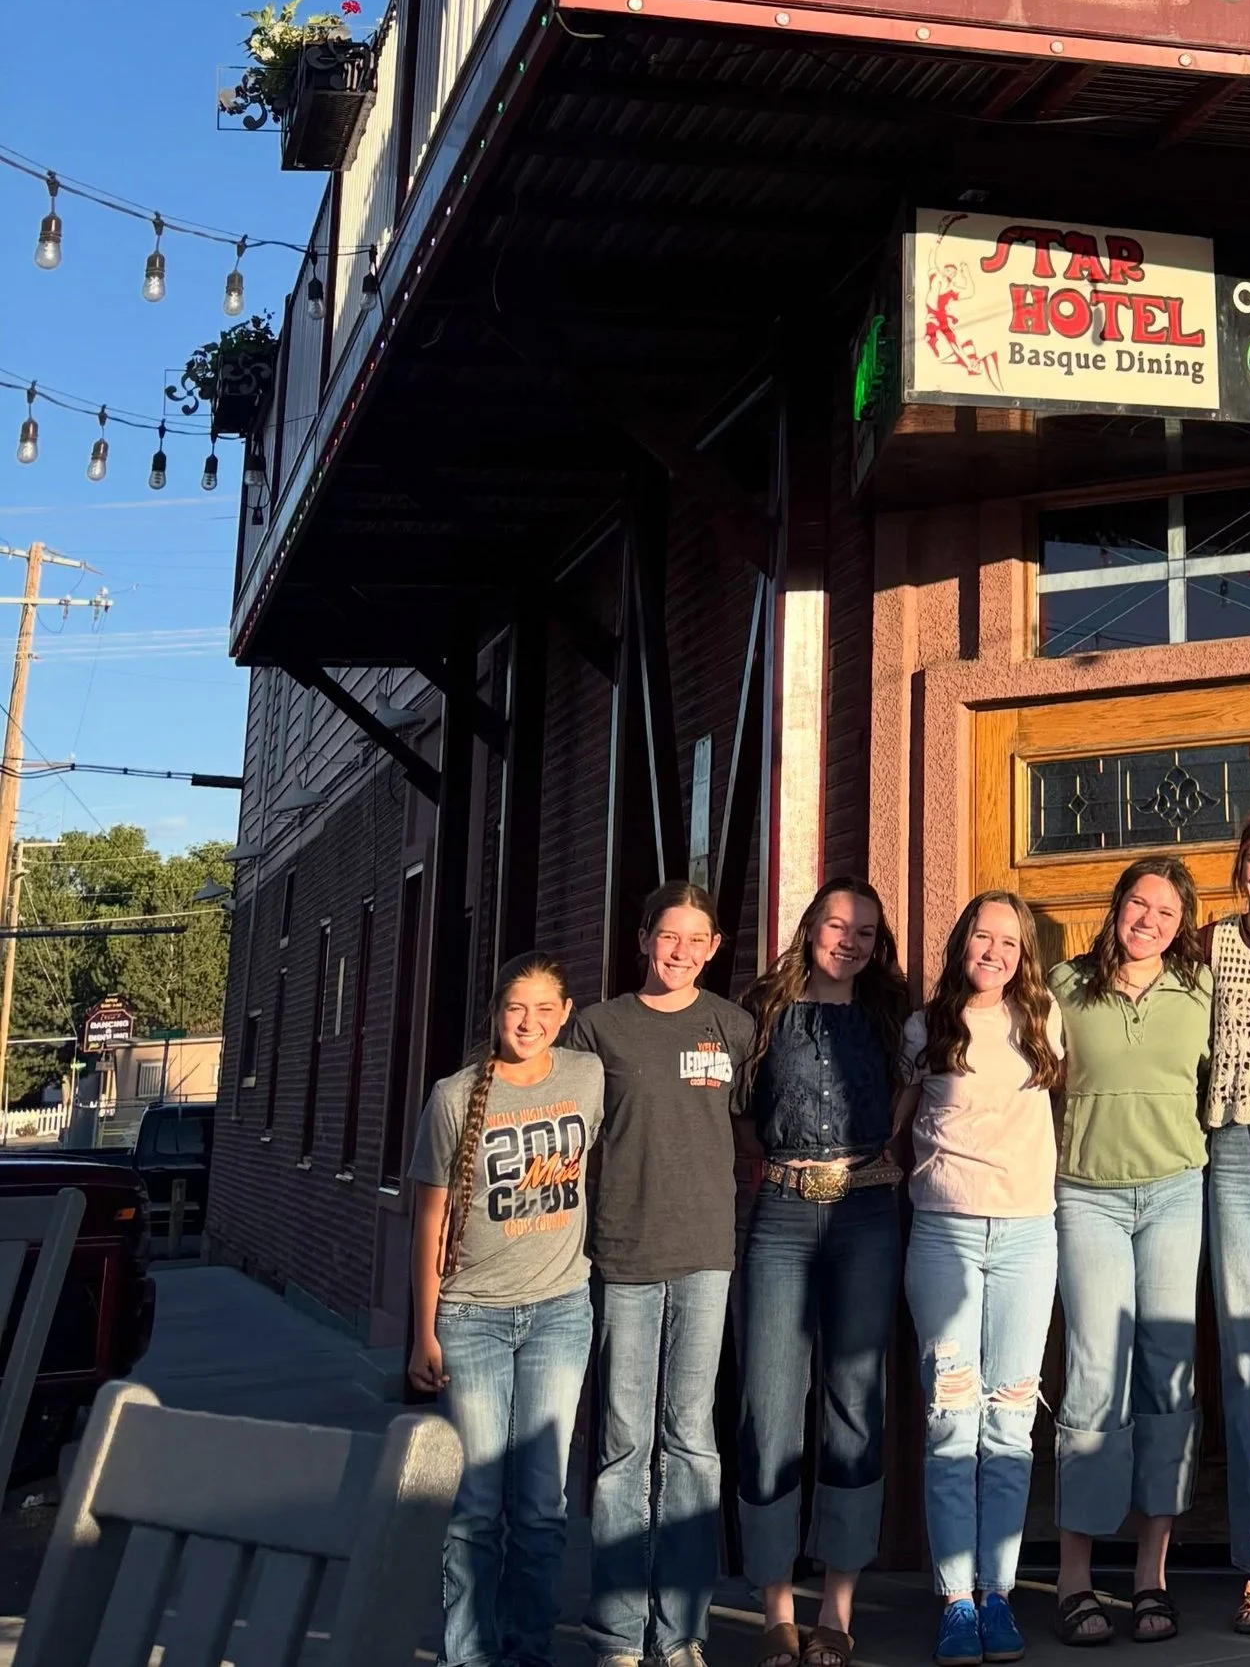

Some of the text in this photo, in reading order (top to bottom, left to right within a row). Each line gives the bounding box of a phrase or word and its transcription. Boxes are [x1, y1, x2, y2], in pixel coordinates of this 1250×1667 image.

[980, 225, 1146, 286] STAR
[1008, 282, 1206, 348] HOTEL
[1008, 341, 1206, 385] Basque Dining
[482, 1112, 587, 1189] 200
[487, 1182, 580, 1223] CLUB
